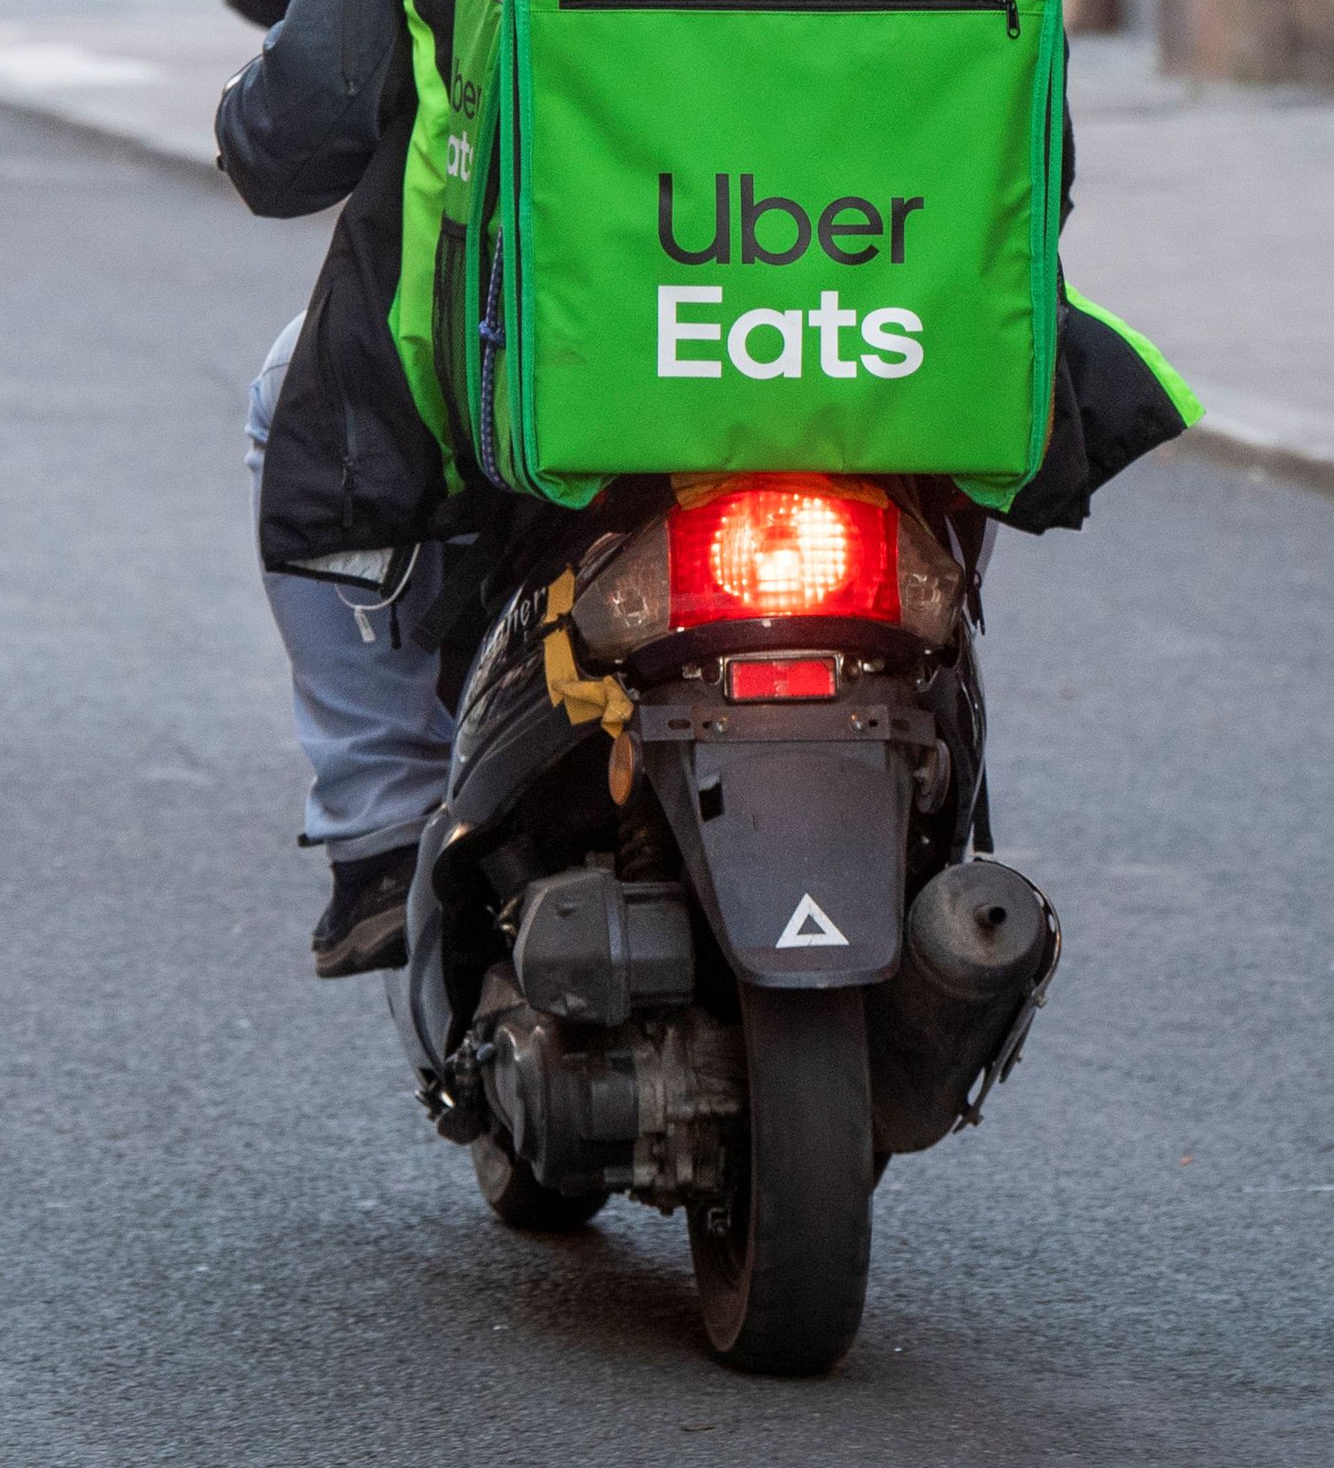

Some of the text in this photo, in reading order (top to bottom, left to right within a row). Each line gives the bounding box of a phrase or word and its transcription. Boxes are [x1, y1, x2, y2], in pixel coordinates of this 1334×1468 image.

[454, 57, 482, 120] ber
[658, 172, 924, 266] Uber
[657, 284, 924, 380] Eats
